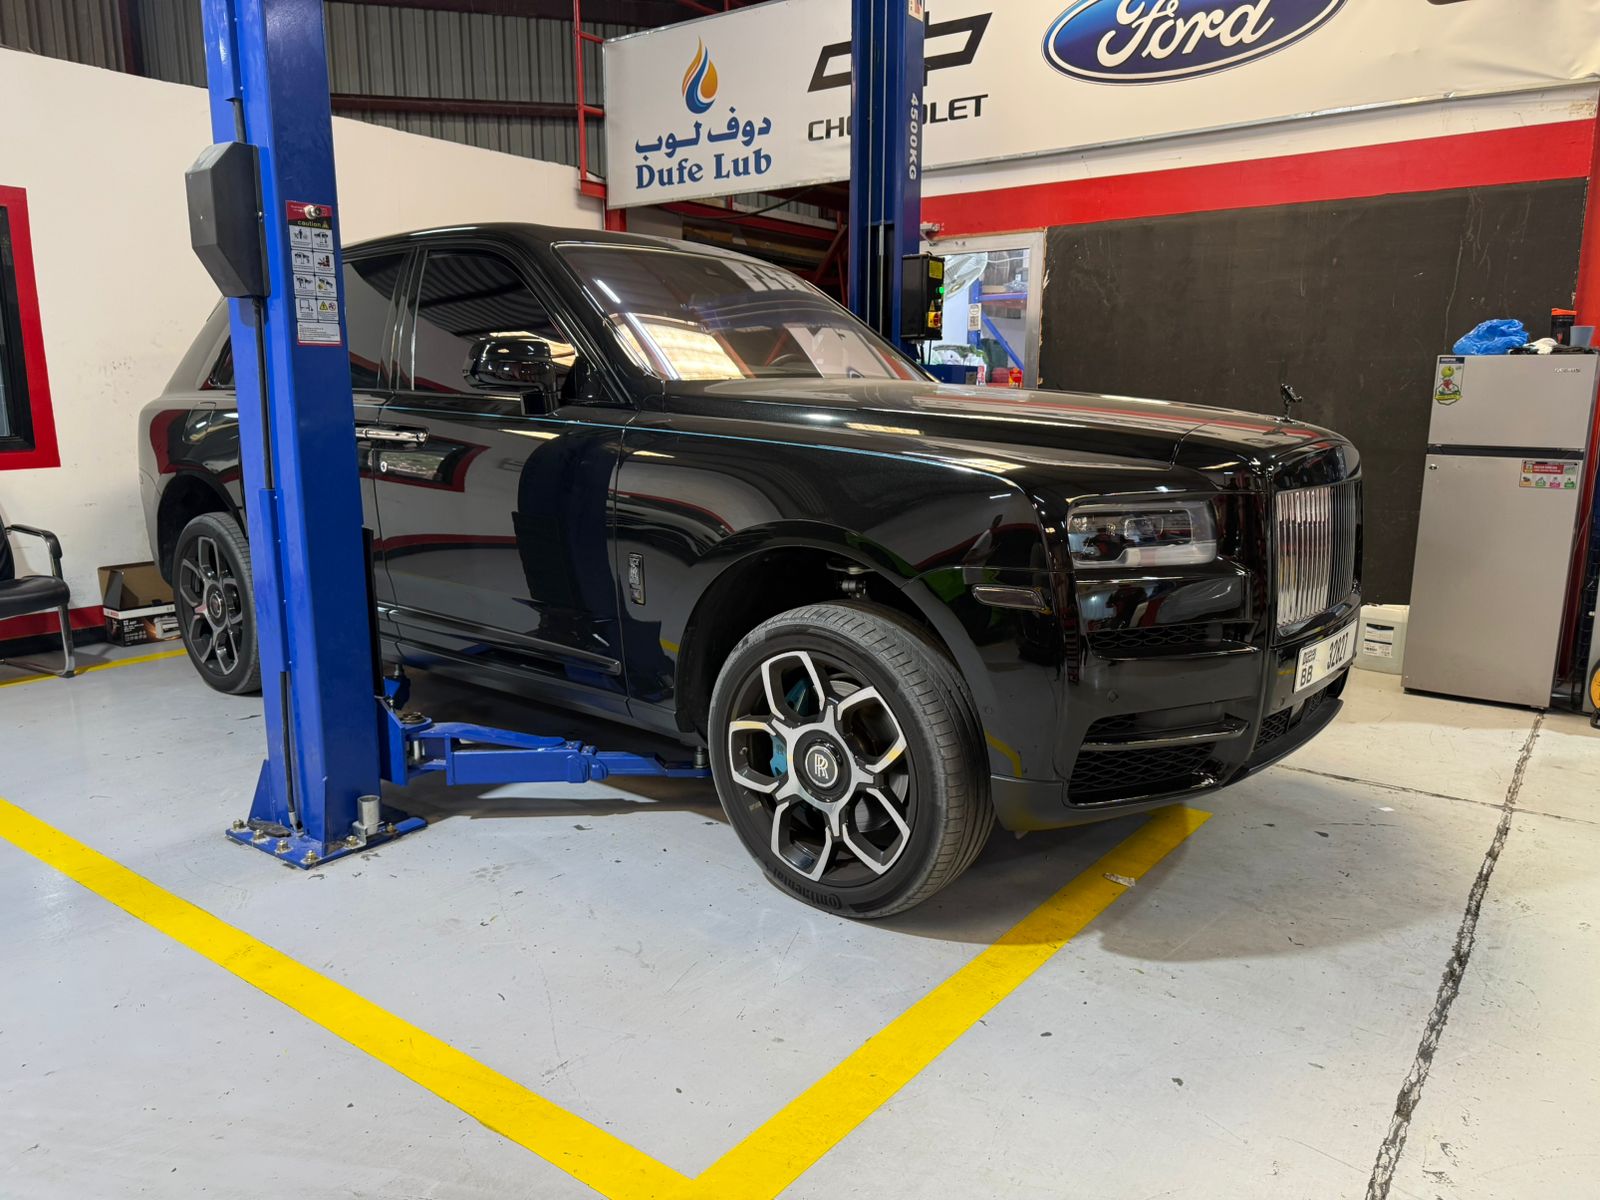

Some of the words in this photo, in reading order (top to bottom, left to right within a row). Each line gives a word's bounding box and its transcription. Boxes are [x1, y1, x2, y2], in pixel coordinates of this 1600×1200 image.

[1096, 0, 1275, 67] Ford
[707, 106, 772, 147] دوف
[807, 94, 989, 141] CHLET
[908, 92, 919, 181] 4500KG
[635, 158, 704, 189] Dufe
[713, 148, 772, 180] Lub
[1327, 632, 1349, 670] 32827
[1300, 665, 1313, 687] BB
